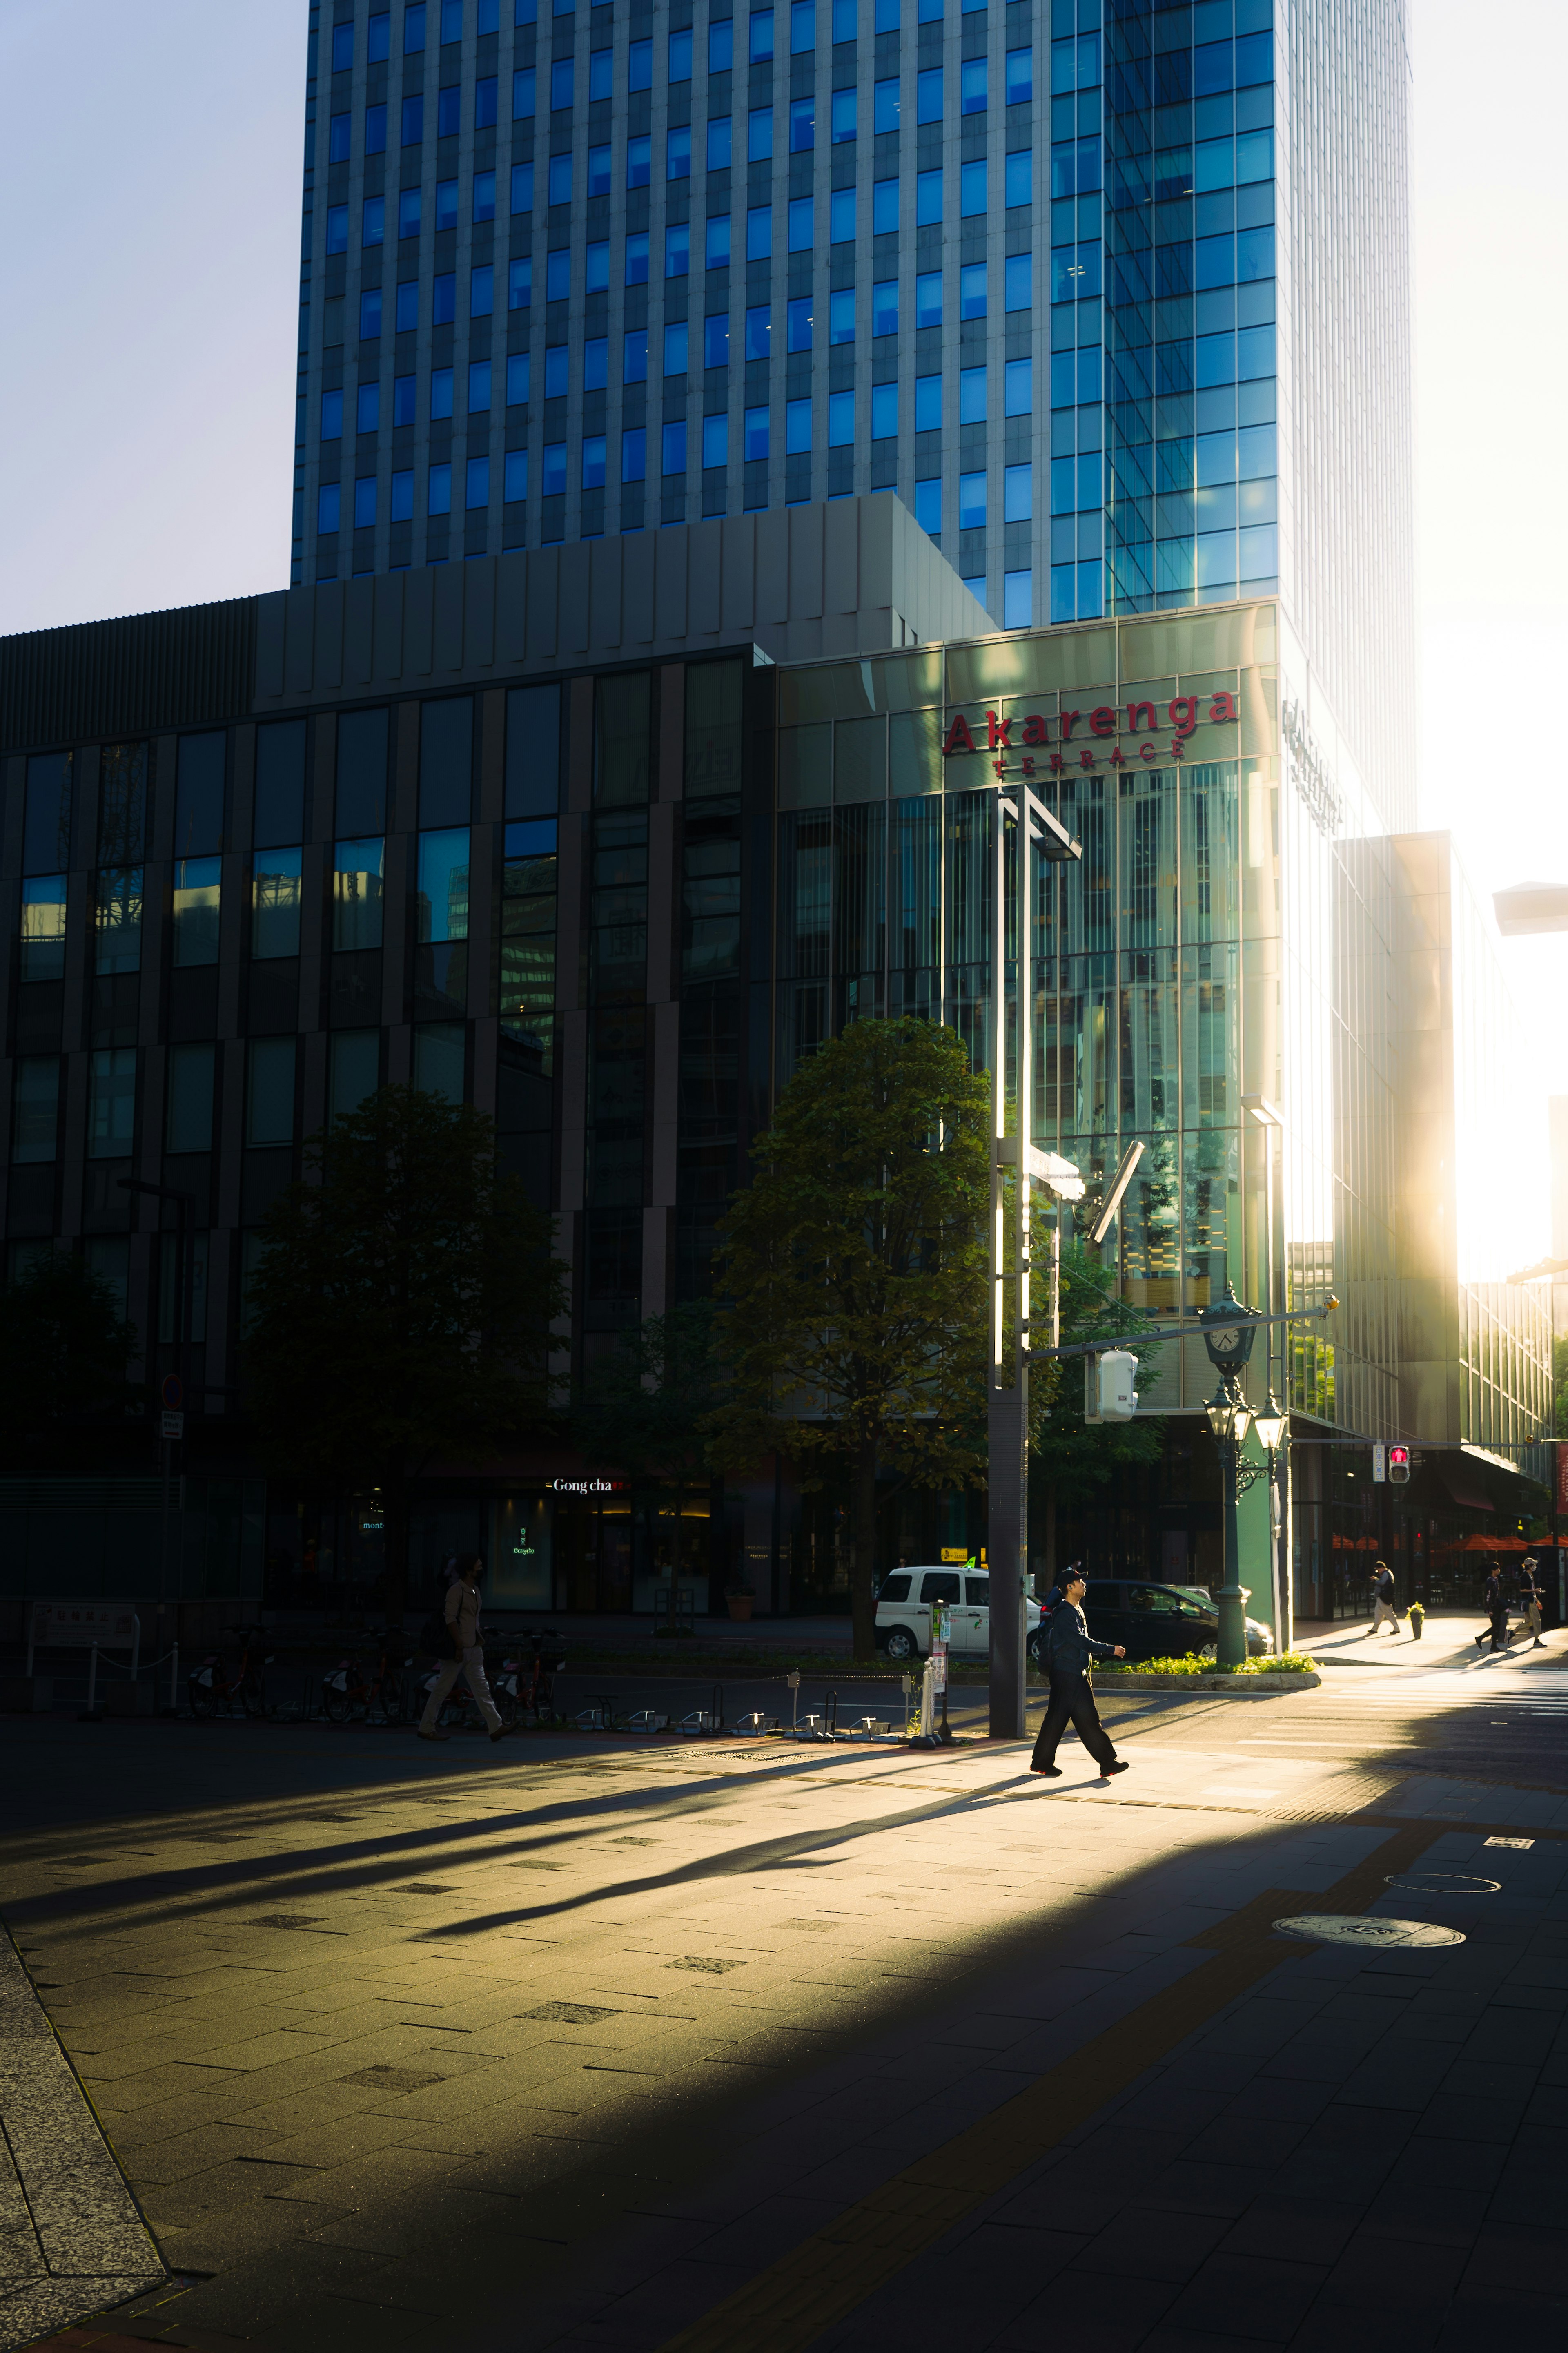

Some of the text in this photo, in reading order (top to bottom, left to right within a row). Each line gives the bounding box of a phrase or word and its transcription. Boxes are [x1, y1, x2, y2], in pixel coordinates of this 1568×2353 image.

[942, 691, 1237, 754] Akarenga
[992, 738, 1184, 778] TERRACE
[554, 1478, 588, 1494] Gong
[590, 1478, 612, 1491] cha
[57, 1610, 109, 1621] 駐輪禁止
